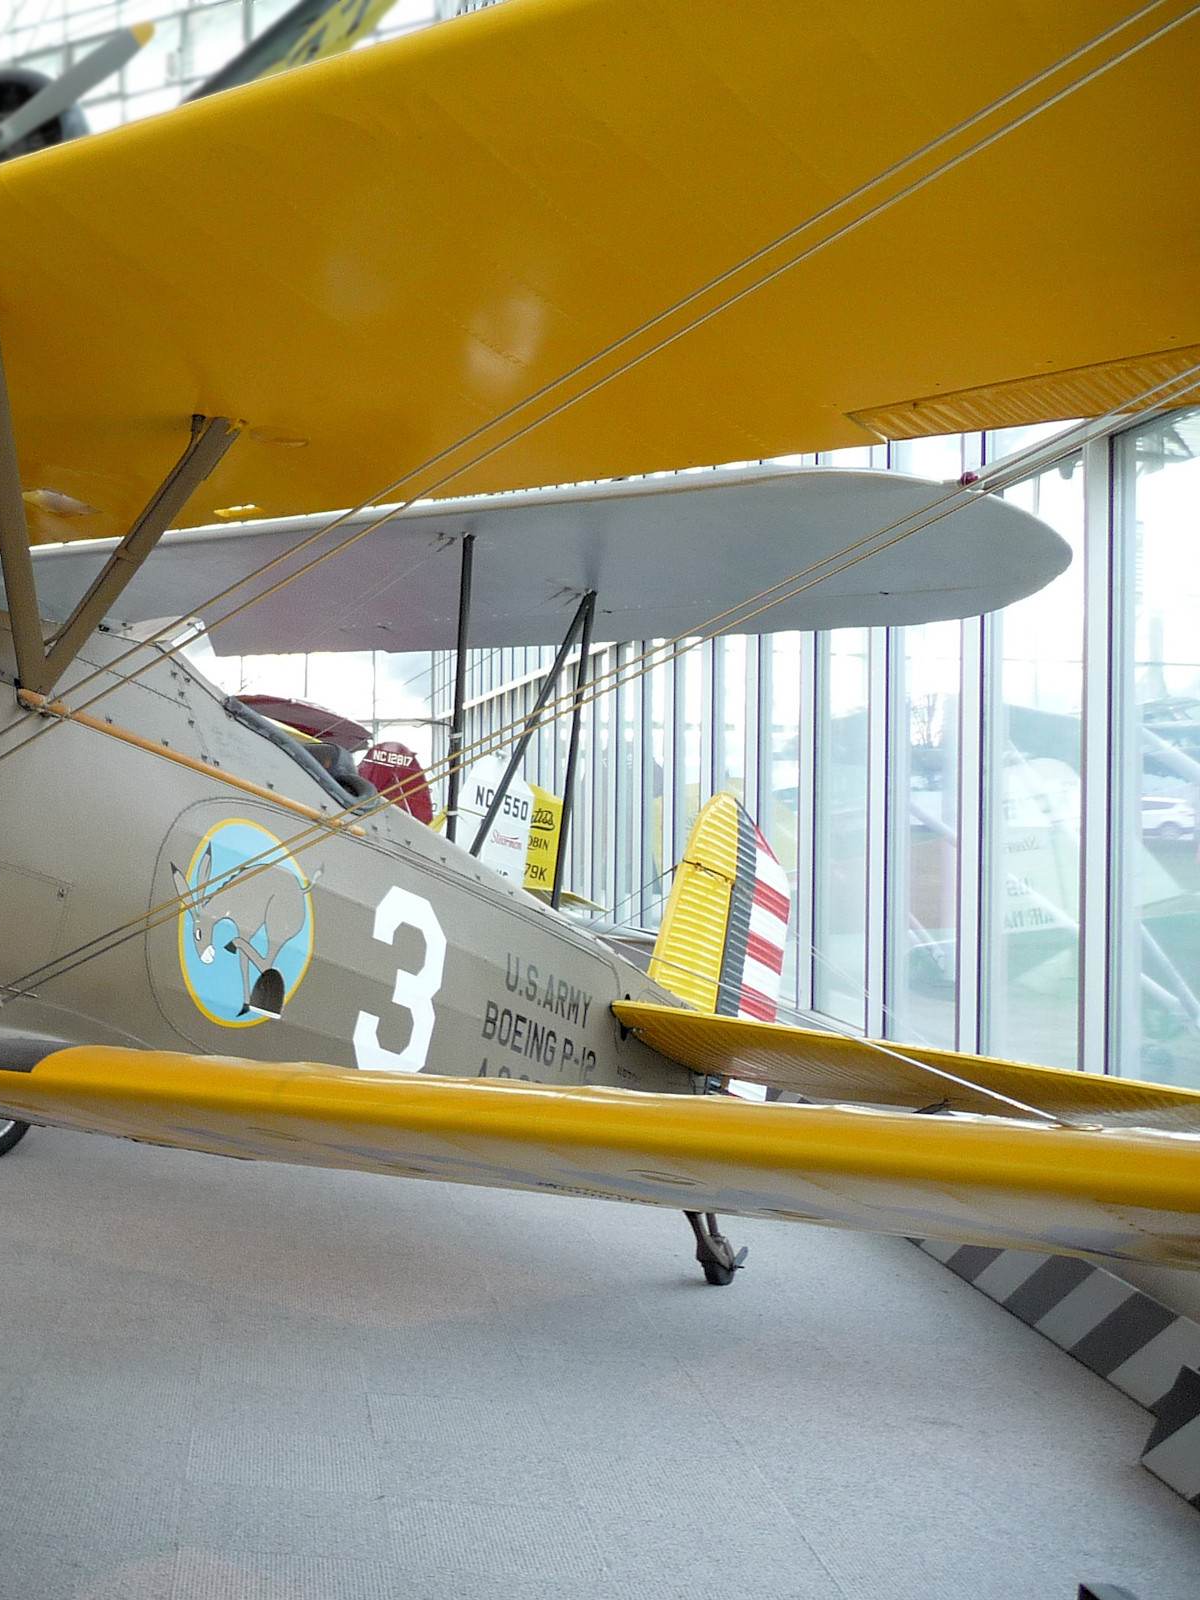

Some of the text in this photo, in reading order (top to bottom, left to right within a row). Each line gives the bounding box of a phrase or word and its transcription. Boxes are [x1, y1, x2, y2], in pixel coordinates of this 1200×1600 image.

[373, 749, 387, 762] NC
[475, 785, 529, 821] NC550
[353, 885, 447, 1073] 3
[482, 1000, 557, 1067] BOEING
[559, 1037, 597, 1086] P-12
